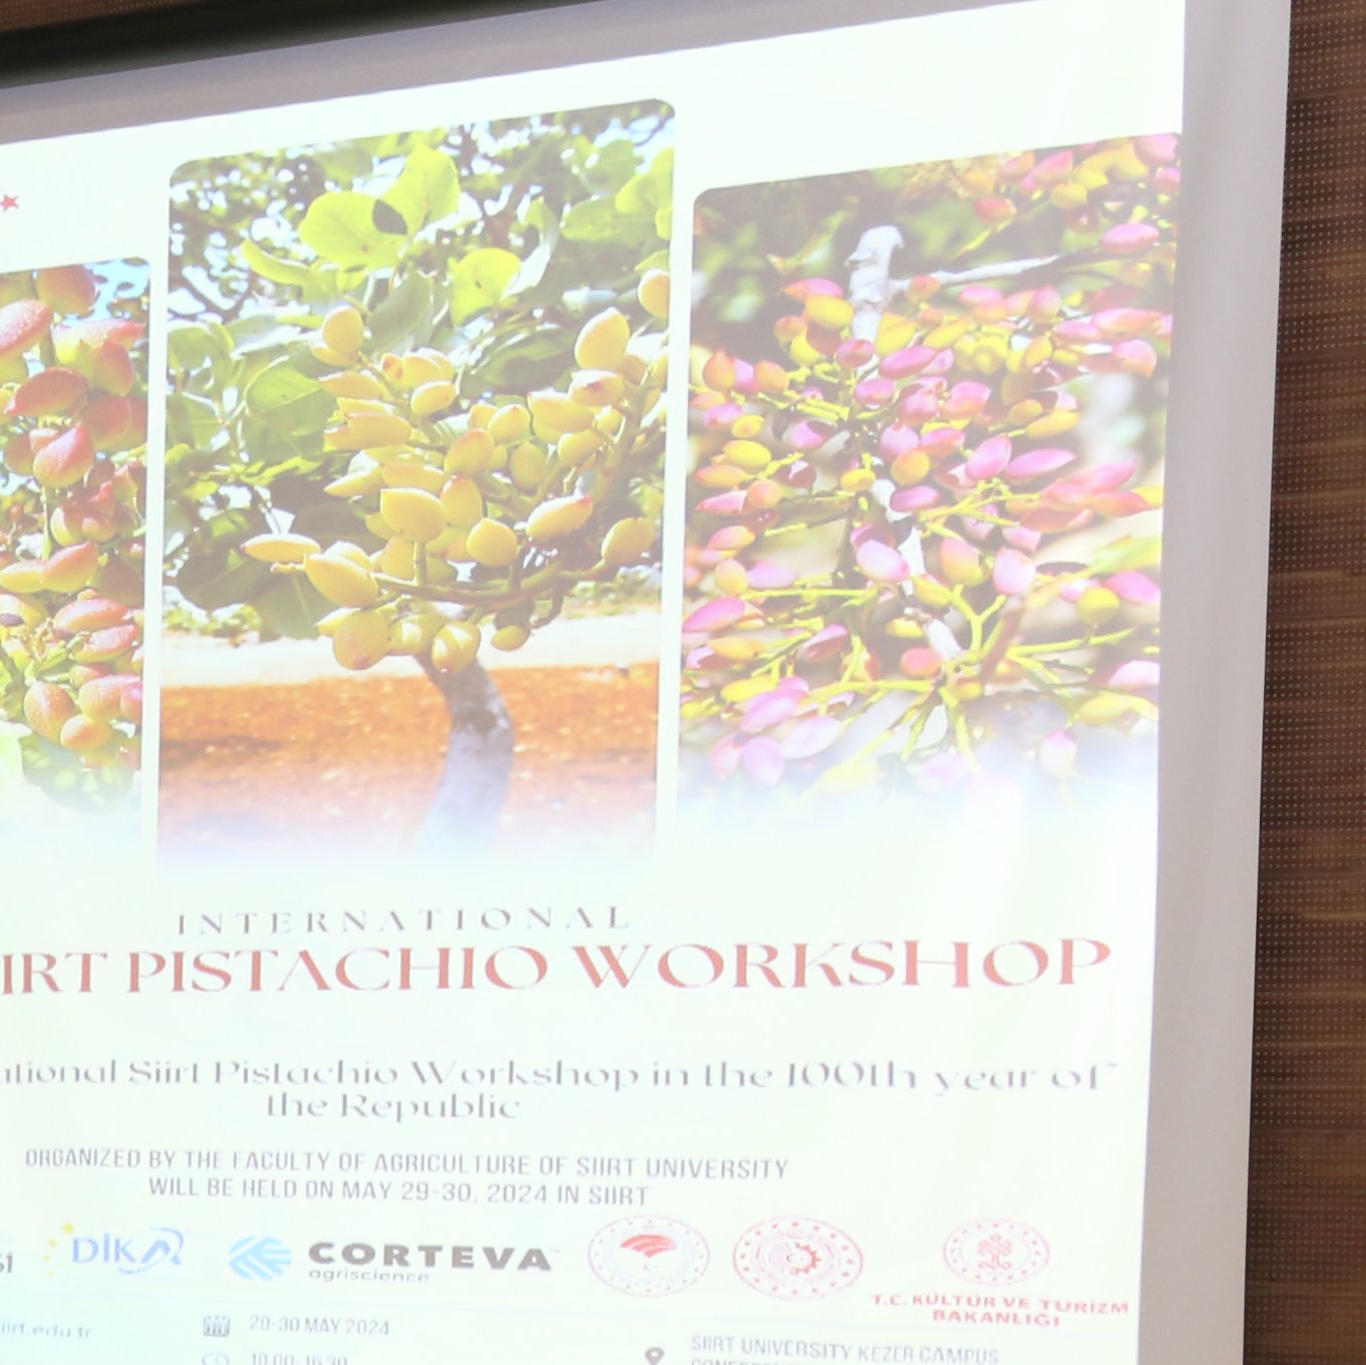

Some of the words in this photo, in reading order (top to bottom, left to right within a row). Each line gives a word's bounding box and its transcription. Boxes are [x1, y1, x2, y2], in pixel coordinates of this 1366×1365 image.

[177, 905, 631, 936] INTERNATIONAL
[127, 945, 549, 994] PISTACHIO
[571, 938, 1111, 989] WORKSHOP
[129, 1059, 199, 1084] Siirt
[214, 1059, 398, 1085] Pistachio
[411, 1060, 639, 1094] Workshop
[653, 1062, 690, 1088] in
[705, 1060, 773, 1088] the
[787, 1061, 917, 1089] 100th
[934, 1069, 1037, 1097] year
[1051, 1061, 1119, 1090] of
[266, 1090, 327, 1117] the
[340, 1093, 520, 1123] Republic
[25, 1147, 141, 1169] ORGANIZED
[149, 1149, 176, 1170] BY
[184, 1150, 224, 1170] THE
[233, 1150, 331, 1172] FACULTY
[338, 1151, 366, 1172] OF
[374, 1152, 530, 1176] AGRICULTURE
[539, 1155, 567, 1176] OF
[576, 1156, 637, 1178] SIIRT
[645, 1157, 789, 1180] UNIVERSITY
[149, 1176, 198, 1197] WILL
[207, 1177, 233, 1198] BE
[242, 1178, 297, 1199] HELD
[305, 1180, 334, 1200] ON
[341, 1180, 392, 1201] MAY
[487, 1183, 548, 1204] 2024
[557, 1185, 580, 1205] IN
[588, 1185, 650, 1207] SIIRT
[308, 1268, 431, 1284] agriscience
[1003, 1295, 1030, 1310] VE
[304, 1316, 341, 1334] MAY
[346, 1317, 390, 1336] 2024
[741, 1337, 852, 1361] UNIVERSITY
[858, 1345, 914, 1363] KEZER
[919, 1346, 999, 1365] CAMPUS
